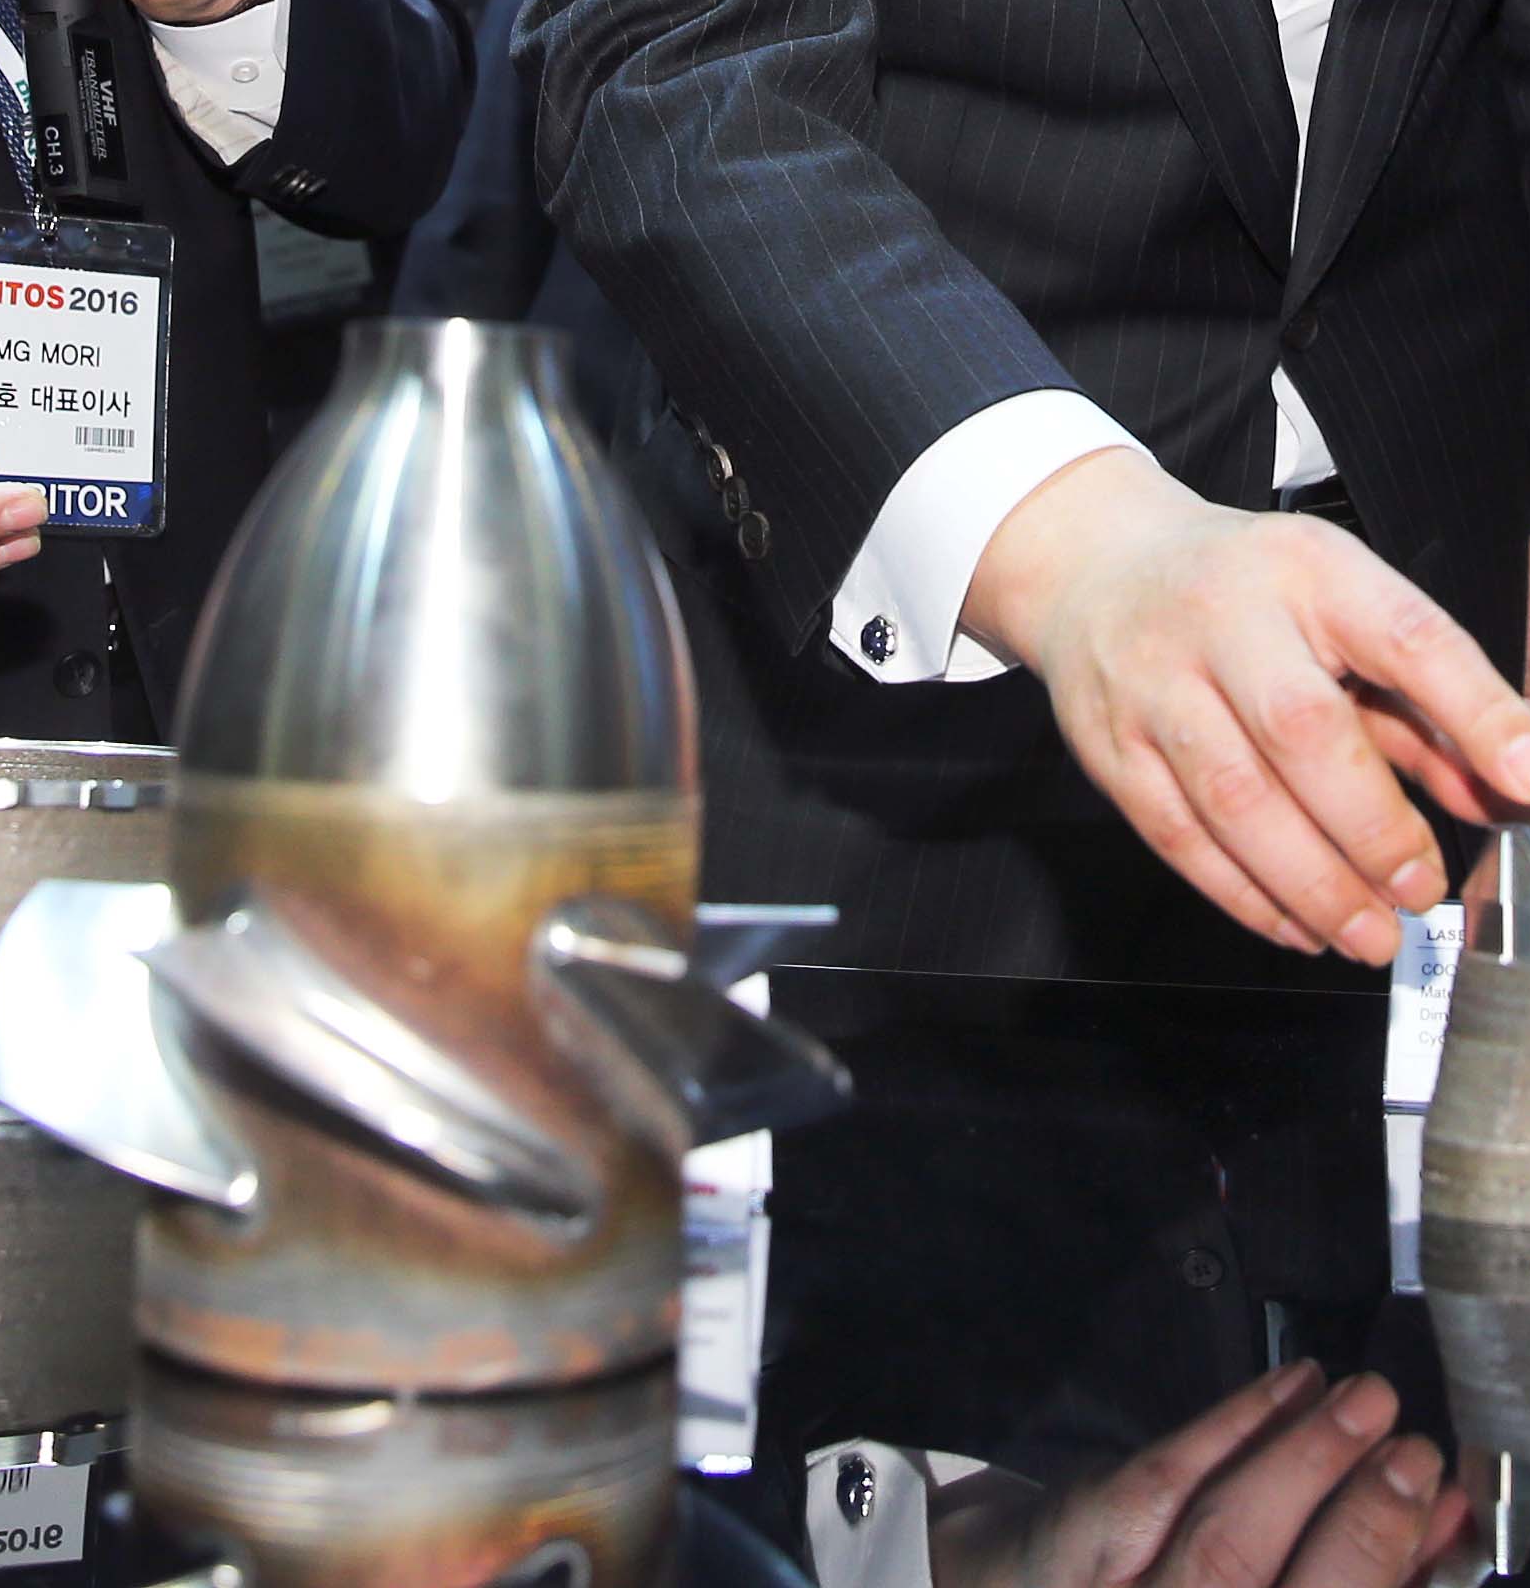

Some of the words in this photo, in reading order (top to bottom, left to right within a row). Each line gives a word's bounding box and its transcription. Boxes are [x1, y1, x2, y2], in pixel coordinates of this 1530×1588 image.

[83, 48, 109, 161] TRANSMITTER
[99, 80, 118, 127] VHF
[44, 125, 64, 175] CH.3
[41, 342, 101, 368] MORI
[32, 386, 132, 418] 대표이사
